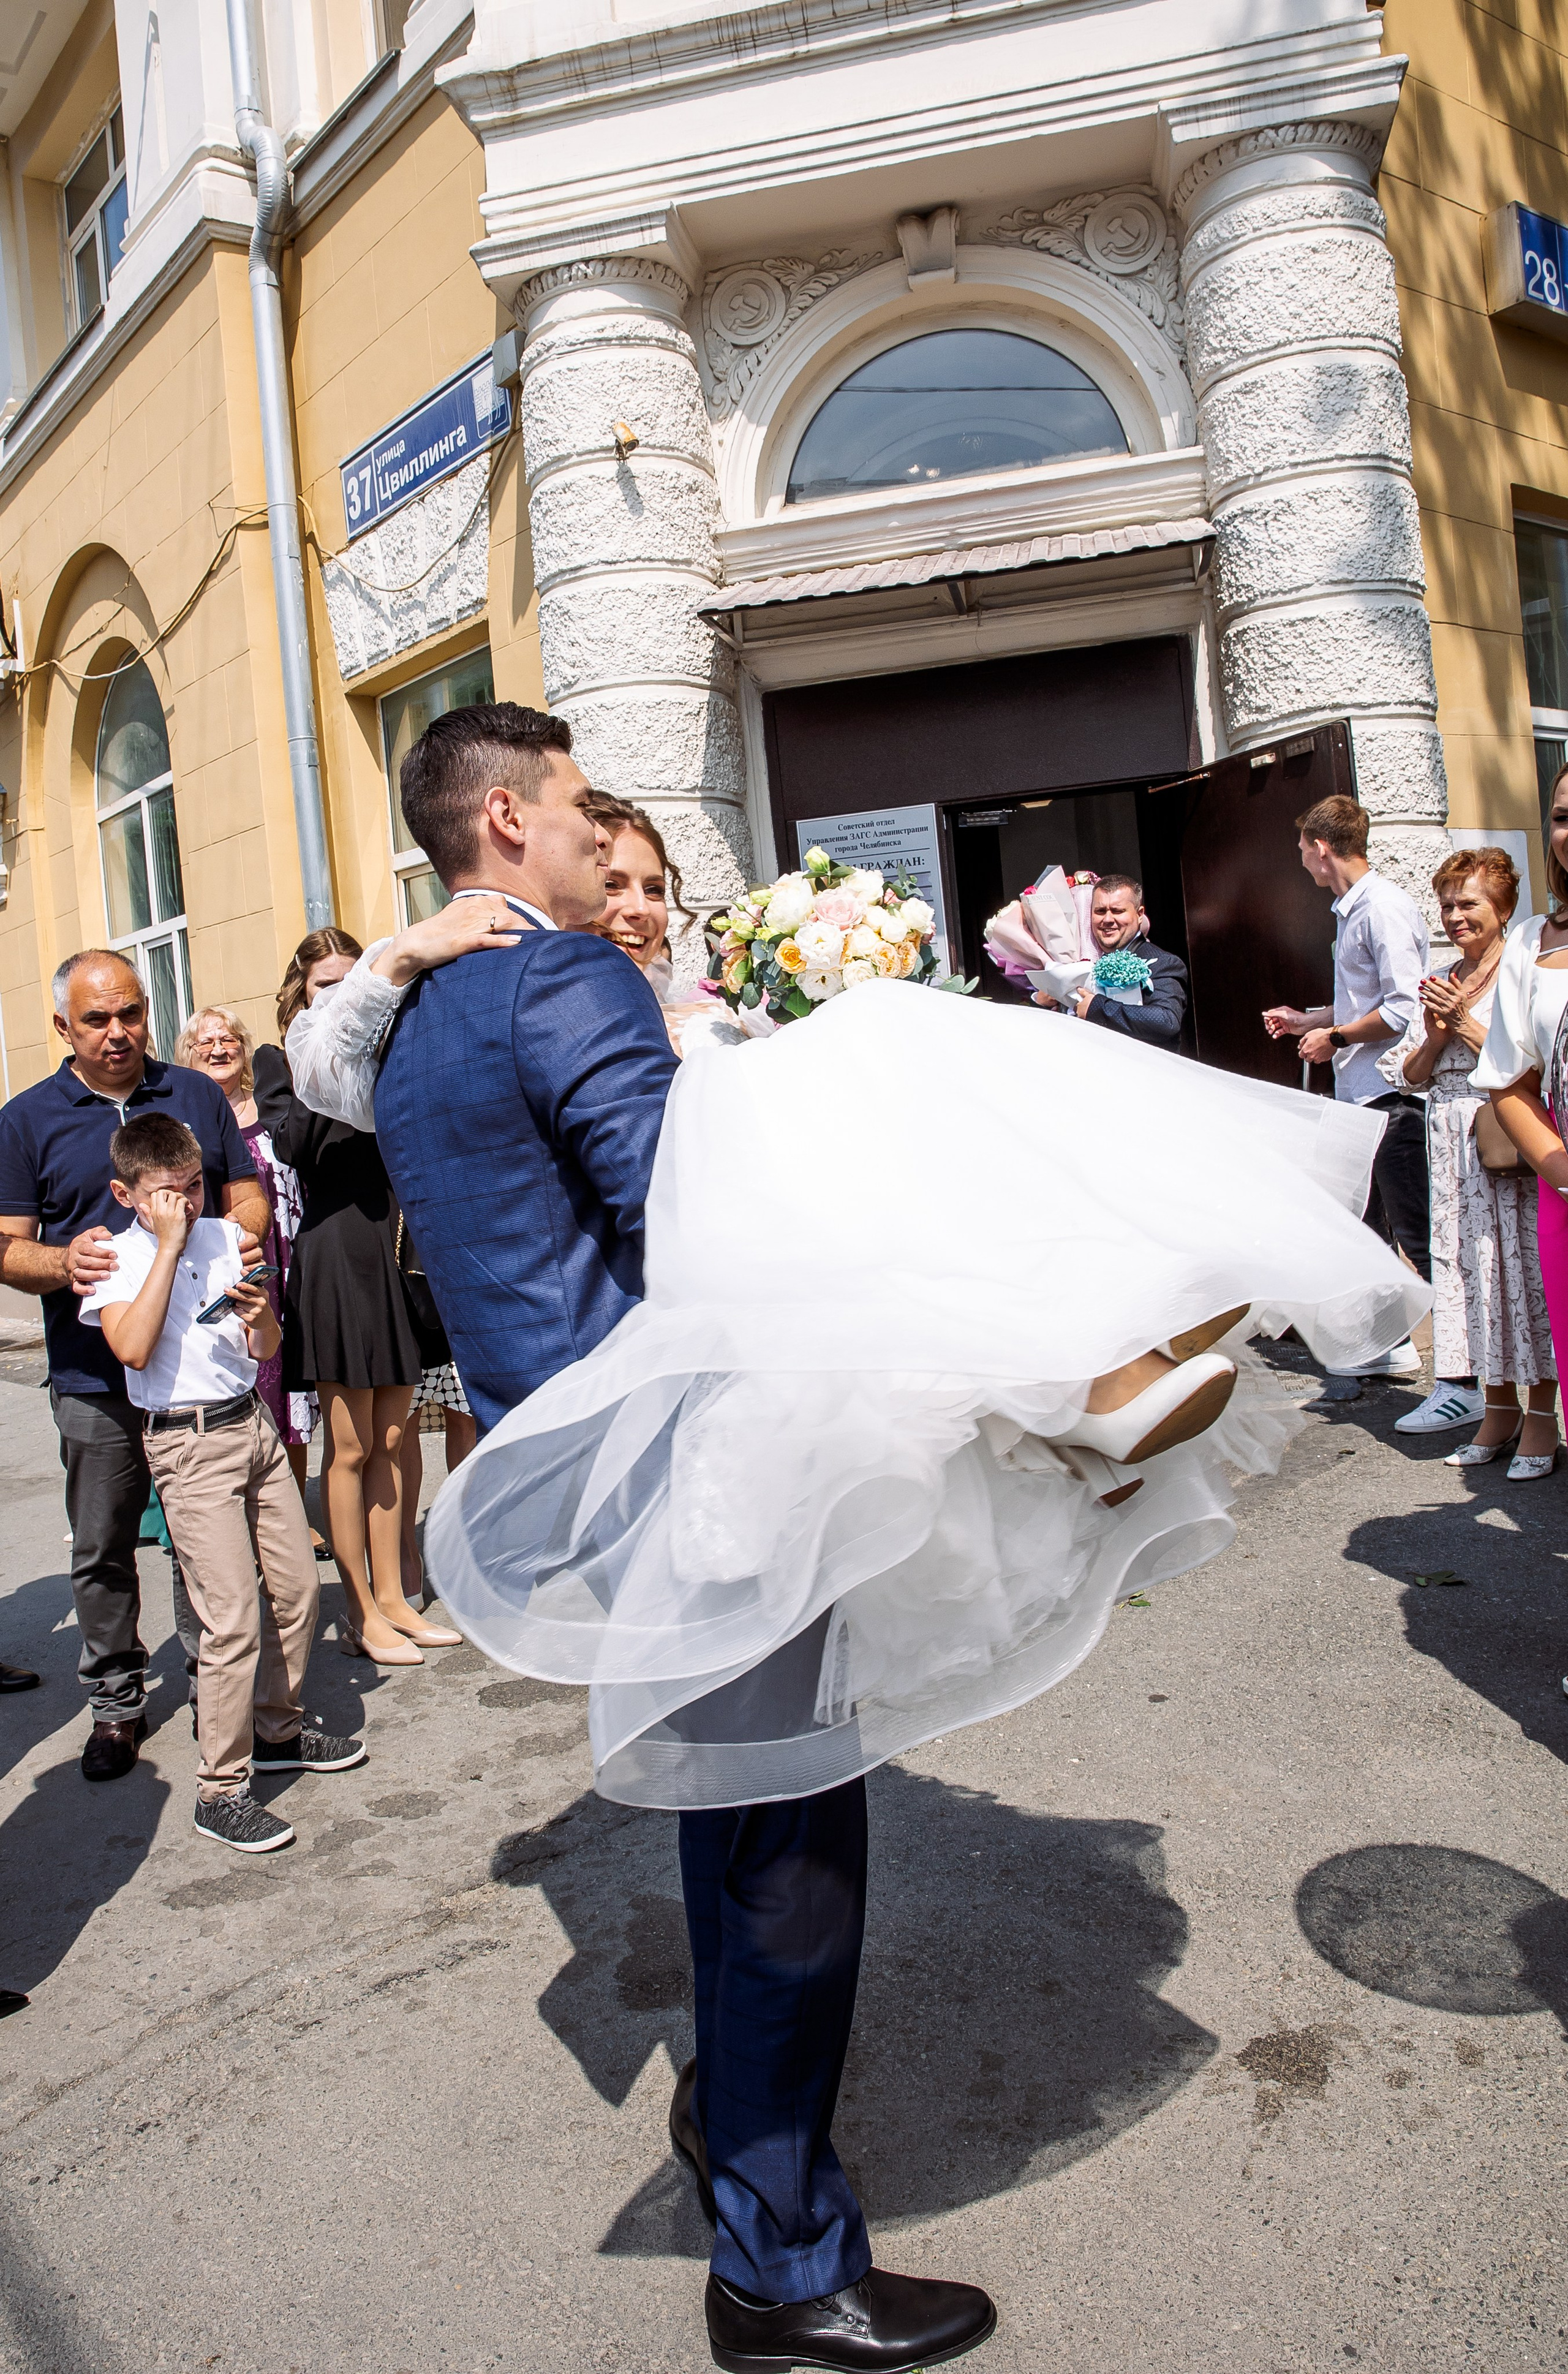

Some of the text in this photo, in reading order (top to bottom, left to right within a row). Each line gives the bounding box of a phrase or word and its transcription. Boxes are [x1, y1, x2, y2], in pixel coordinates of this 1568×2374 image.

[1525, 250, 1560, 306] 28
[375, 439, 405, 474] улица
[377, 425, 467, 501] Цвиллинга
[347, 465, 372, 520] 37
[806, 826, 929, 846] Управления ЗАГС Администрации
[837, 818, 895, 831] Советский отдел
[834, 840, 901, 853] города Челябинска
